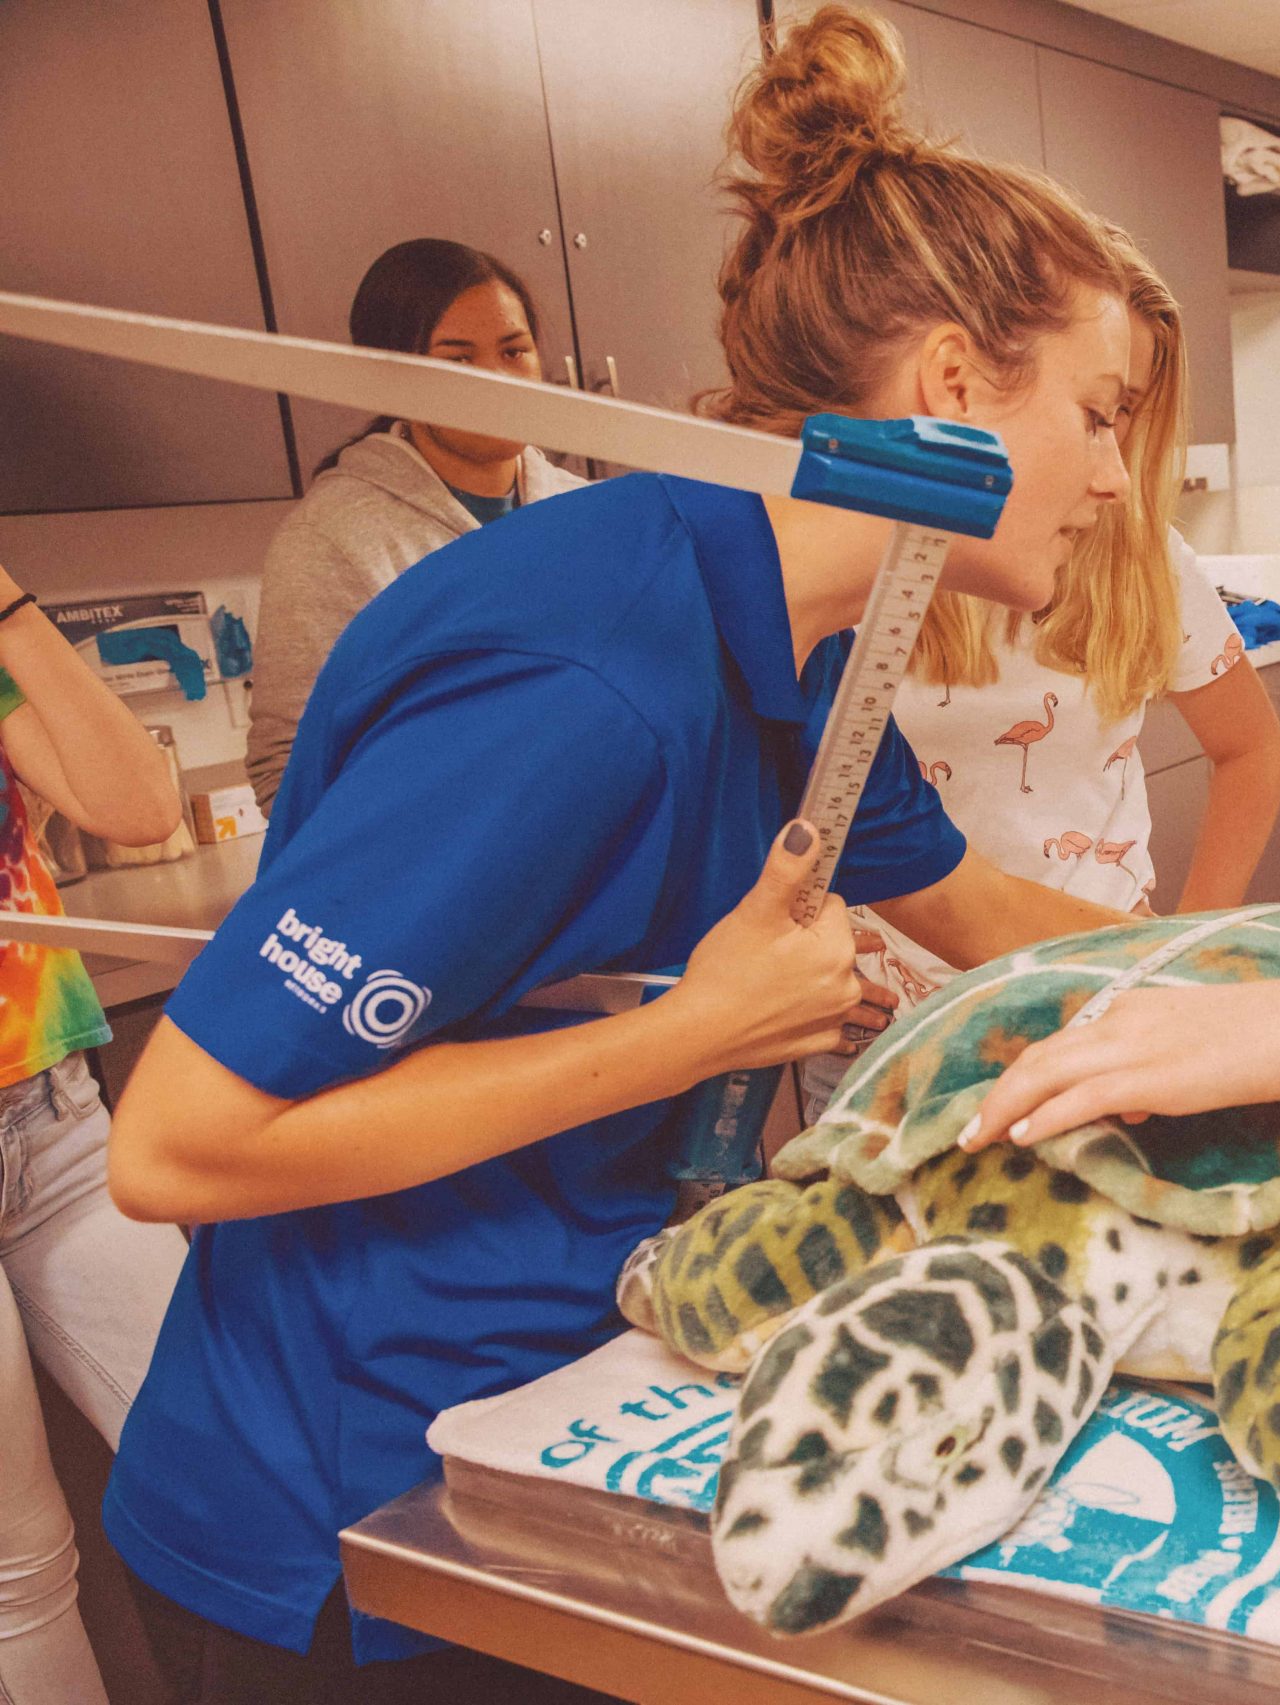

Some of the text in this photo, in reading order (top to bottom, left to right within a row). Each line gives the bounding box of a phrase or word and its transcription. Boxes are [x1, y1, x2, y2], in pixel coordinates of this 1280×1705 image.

[914, 552, 928, 562] 2
[921, 574, 934, 582] 3
[902, 589, 915, 599] 4
[56, 605, 124, 624] AMBITEX
[908, 611, 921, 620] 5
[889, 626, 901, 636] 6
[895, 647, 907, 656] 7
[876, 661, 889, 671] 8
[883, 682, 895, 690] 9
[862, 696, 877, 711] 10
[869, 717, 884, 731] 11
[850, 730, 865, 745] 12
[857, 749, 872, 763] 13
[838, 764, 853, 778] 14
[846, 782, 860, 796] 15
[828, 796, 842, 810] 16
[835, 814, 848, 828] 17
[824, 845, 838, 859] 19
[803, 905, 817, 920] 23
[276, 908, 362, 979] bright
[259, 933, 343, 1004] house
[541, 1418, 621, 1468] of
